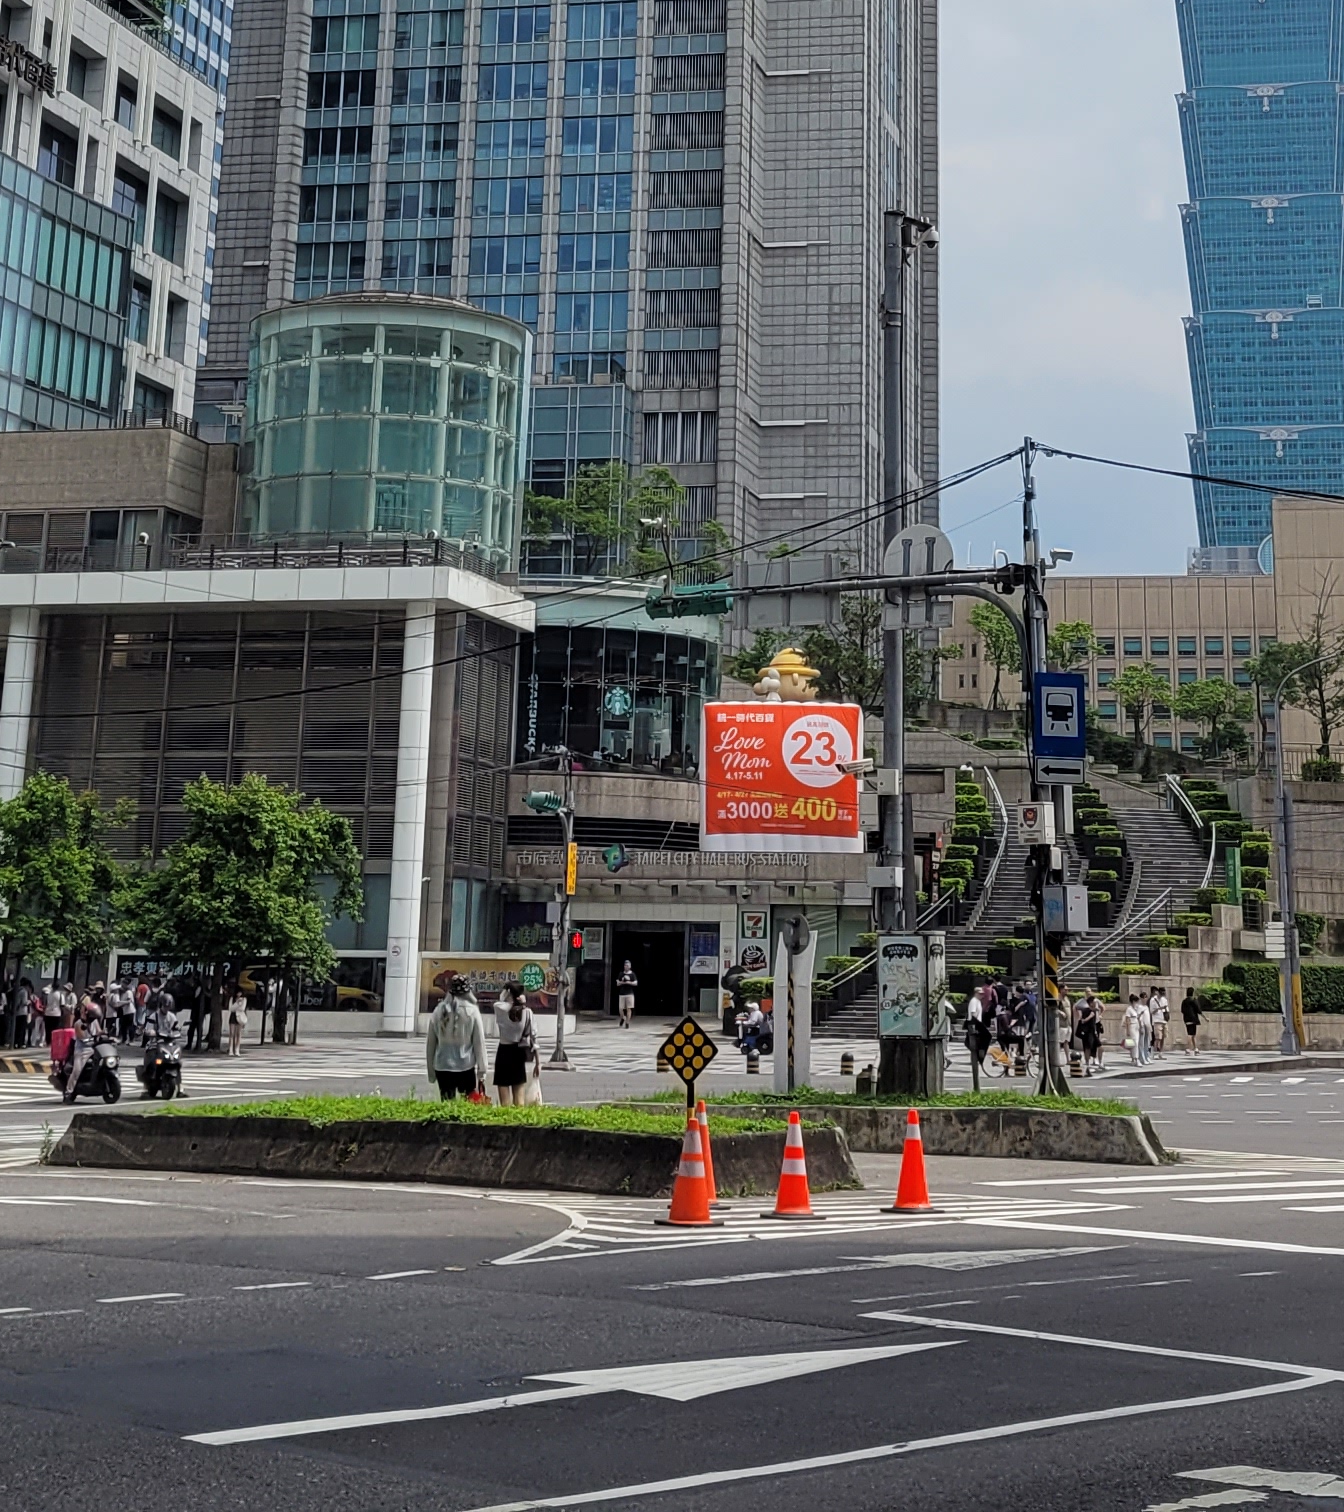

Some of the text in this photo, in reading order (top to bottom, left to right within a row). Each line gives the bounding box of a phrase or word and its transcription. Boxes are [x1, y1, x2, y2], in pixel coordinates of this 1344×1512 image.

[716, 713, 775, 723] 統一時代百貨
[713, 727, 766, 753] Love
[721, 751, 773, 771] Mom
[725, 772, 763, 780] 4.17-5.11
[636, 851, 808, 867] TAIPEI CITY HALL BUS STATION
[523, 974, 543, 985] 25%
